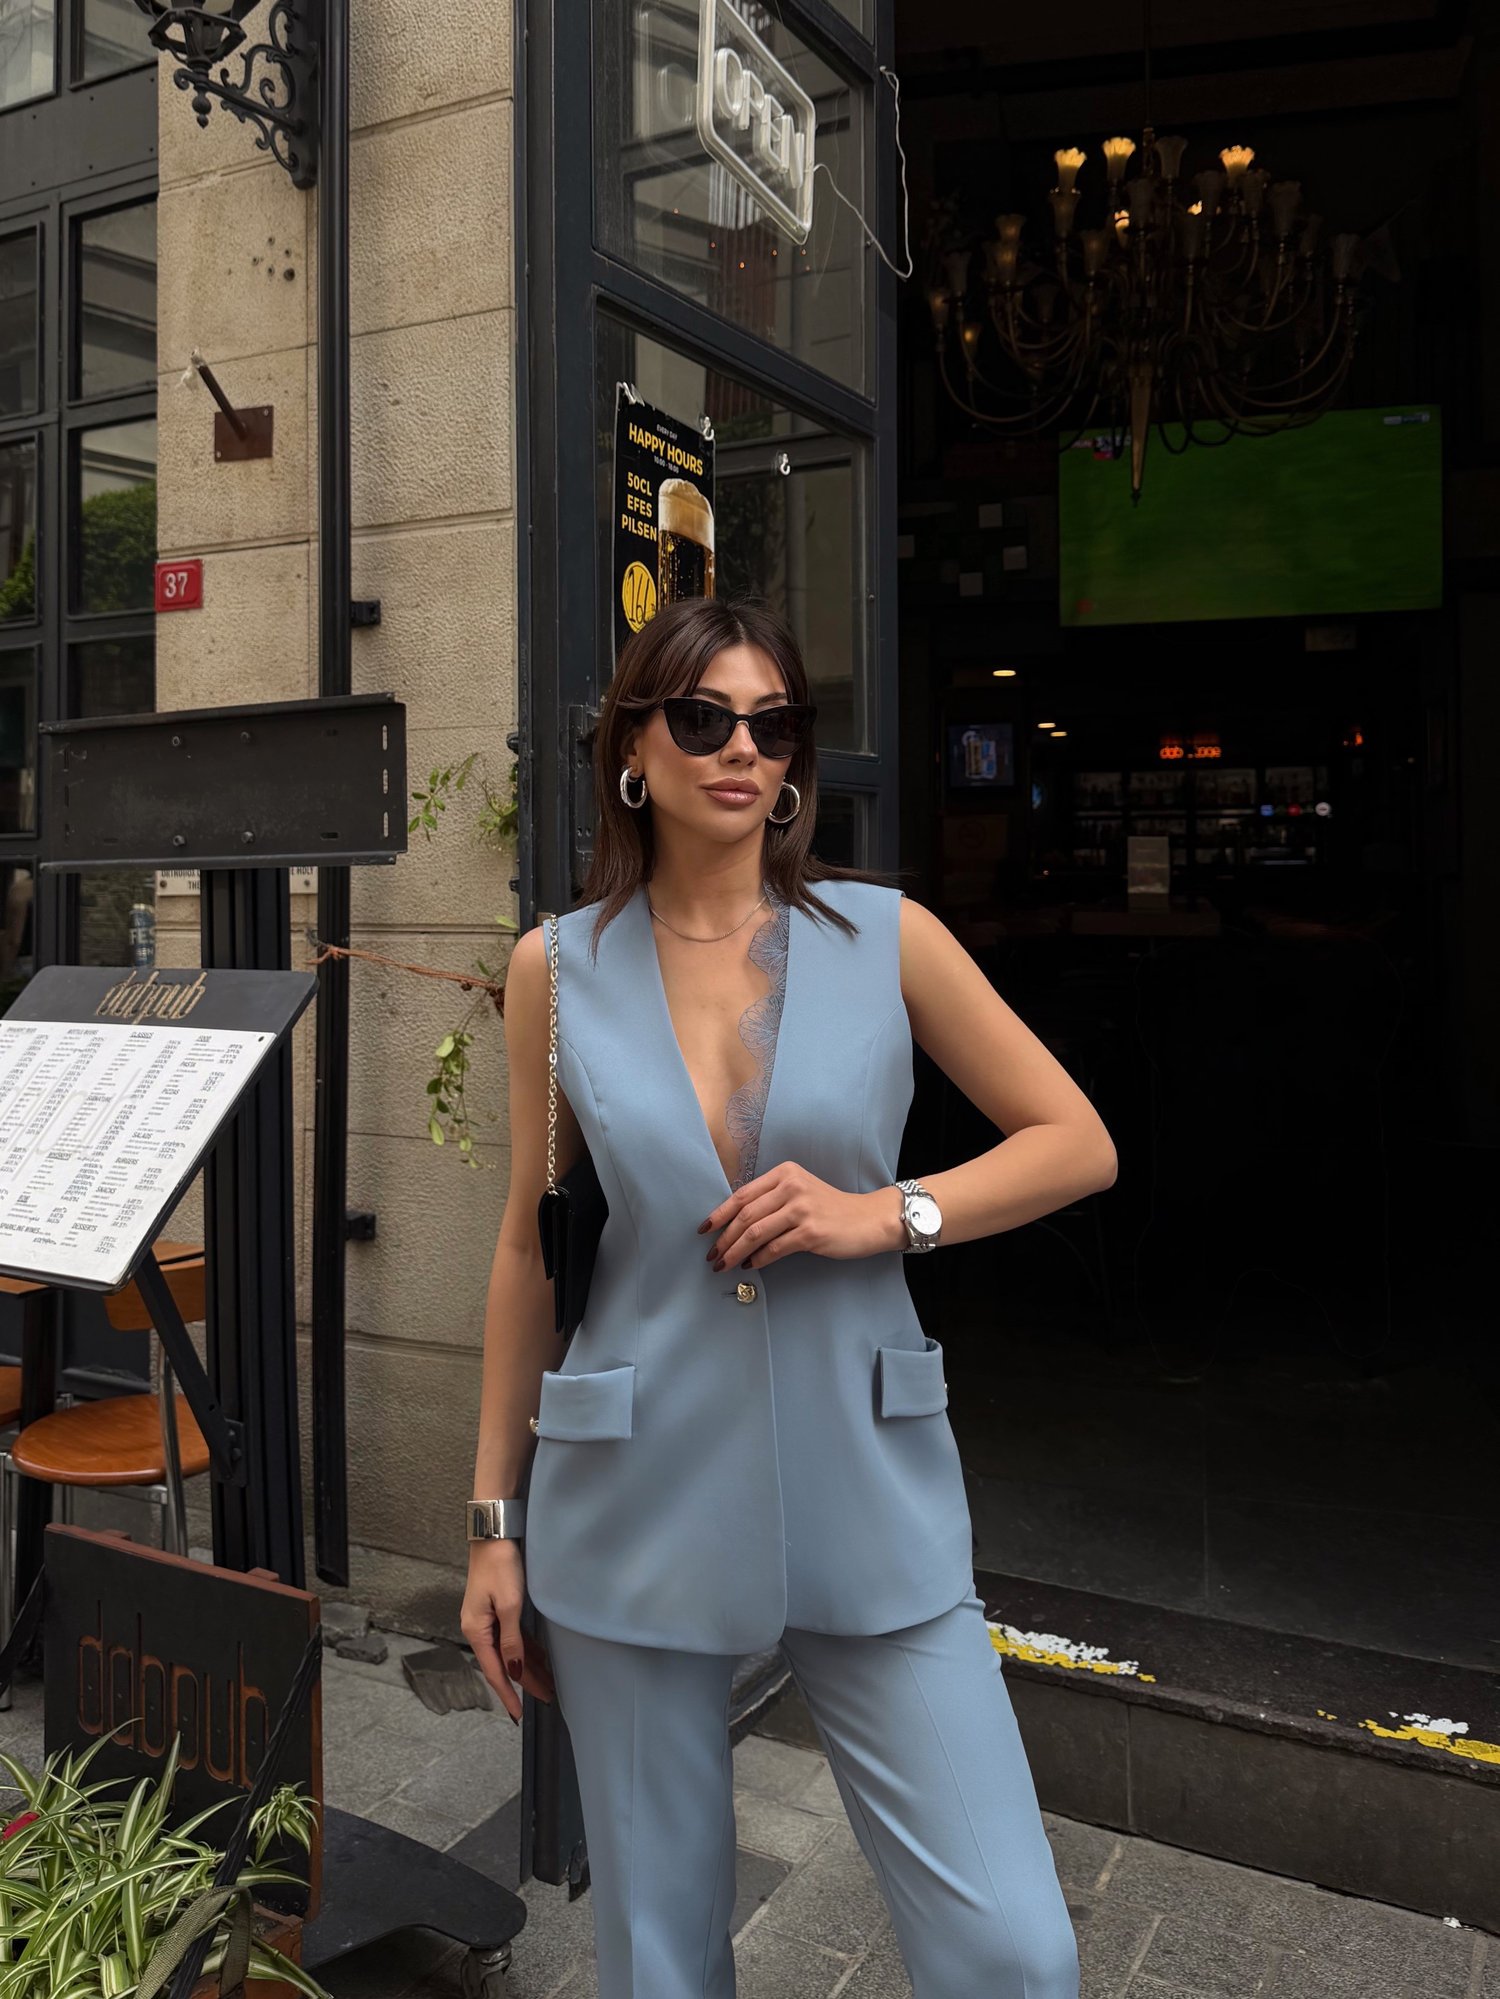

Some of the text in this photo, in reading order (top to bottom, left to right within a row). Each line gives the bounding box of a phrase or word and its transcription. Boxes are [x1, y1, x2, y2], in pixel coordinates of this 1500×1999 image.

[714, 48, 805, 189] OPEN
[629, 422, 665, 457] HAPPY
[667, 443, 703, 476] HOURS
[627, 471, 653, 497] 50CL
[627, 494, 652, 518] EFES
[621, 513, 657, 542] PILSEN
[165, 571, 188, 599] 37
[115, 1157, 139, 1166] BURGERS
[96, 1186, 117, 1195] SNACKS
[71, 1223, 98, 1232] DESSERTS
[78, 1599, 270, 1804] dabpub
